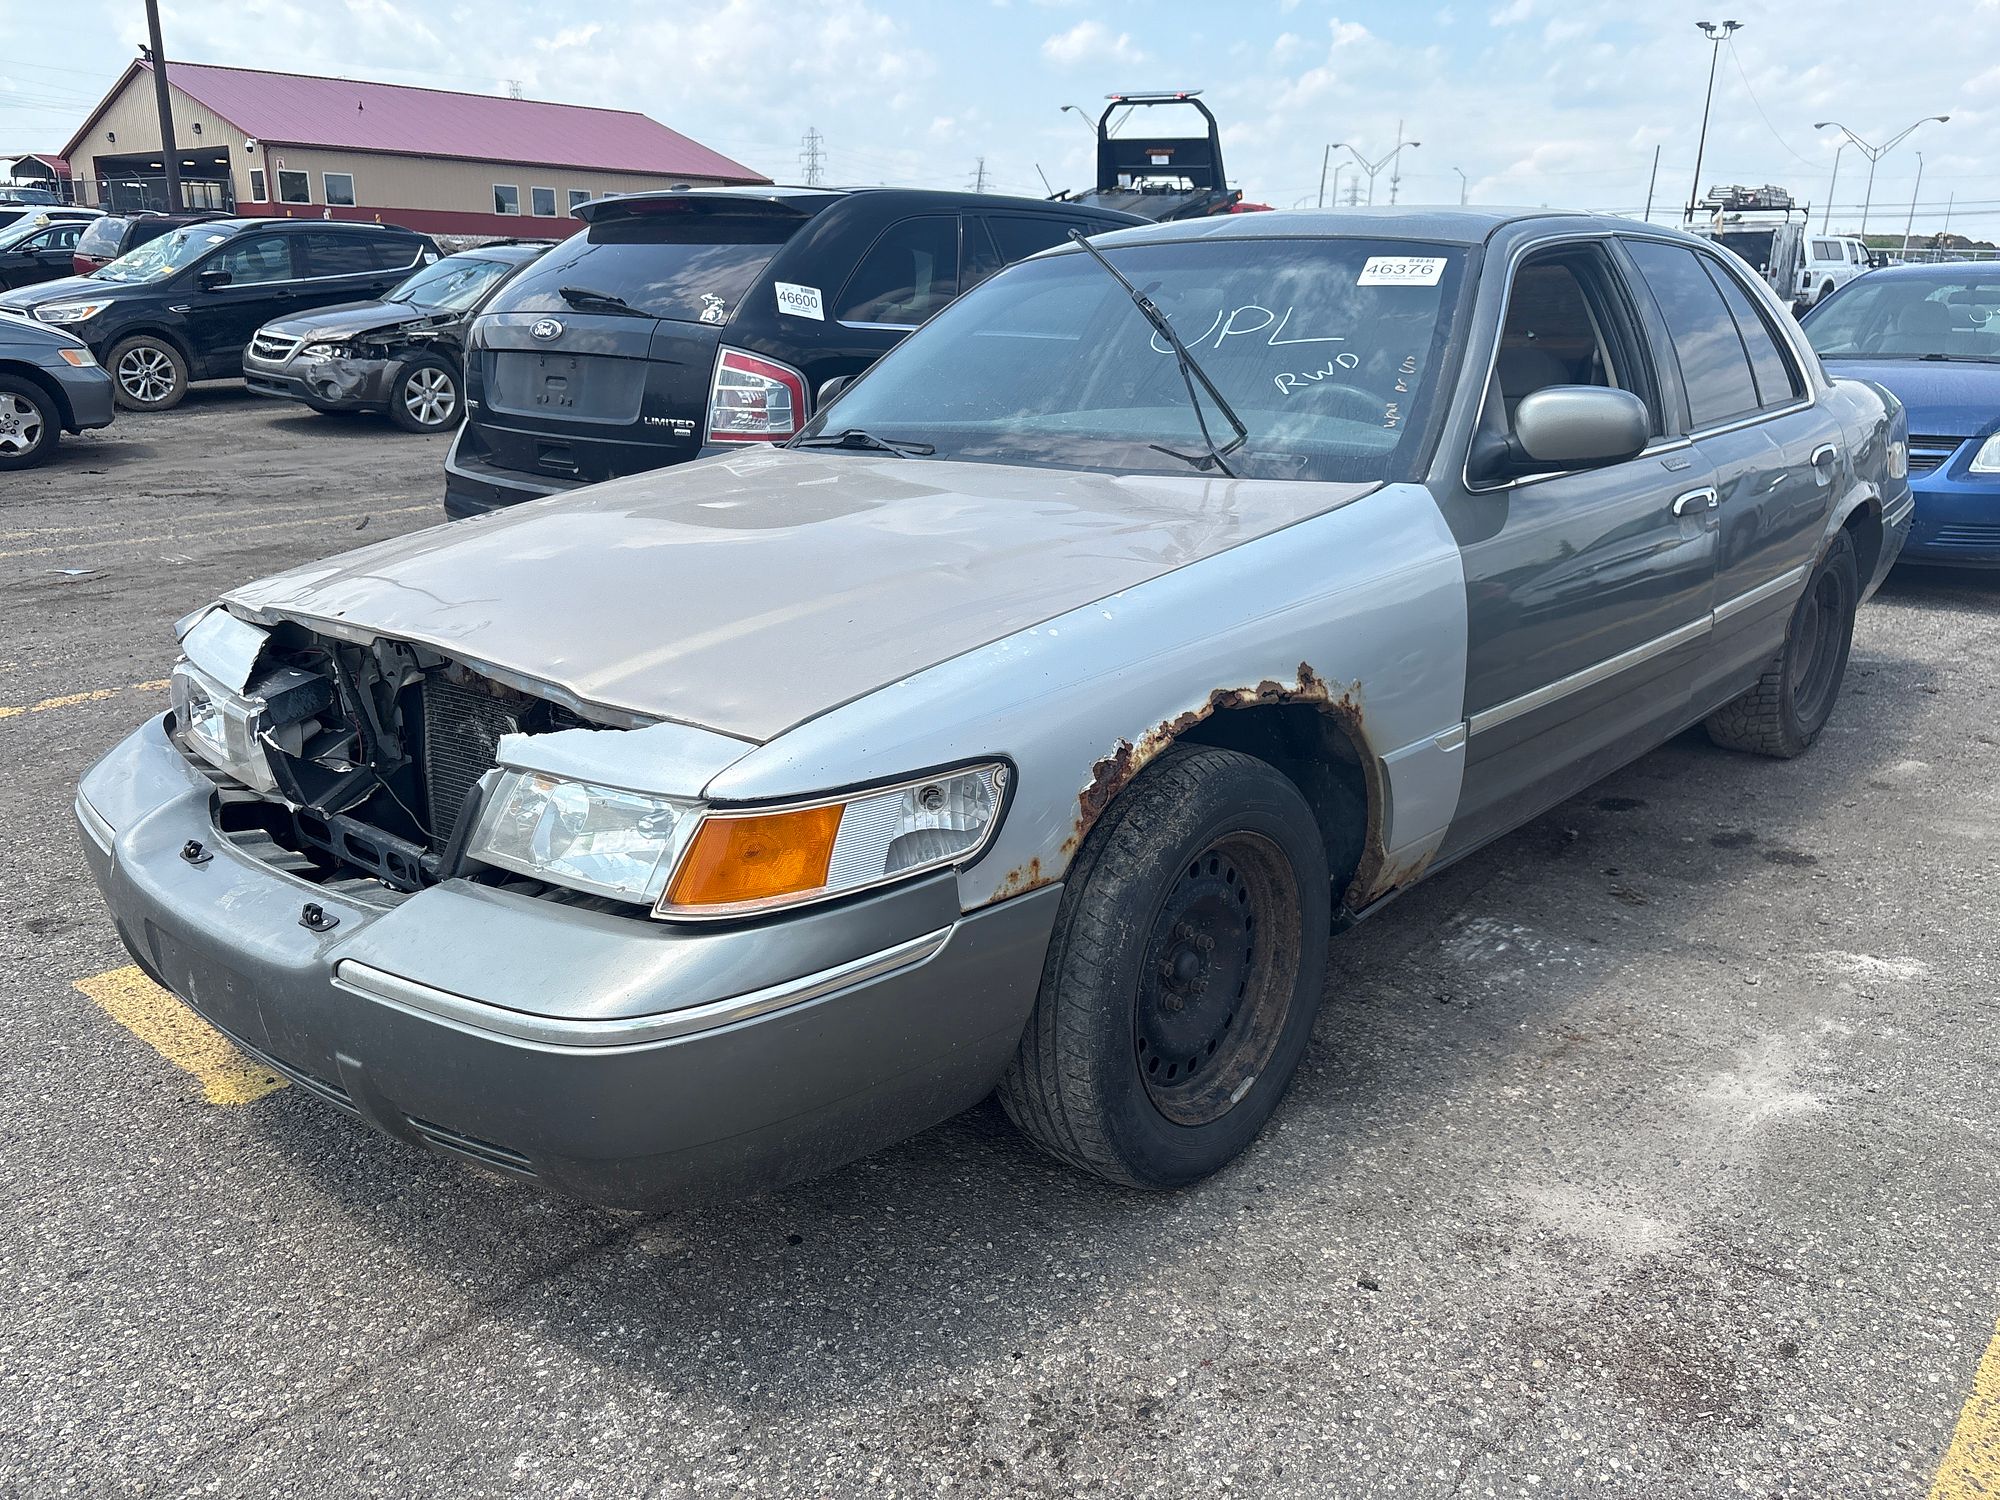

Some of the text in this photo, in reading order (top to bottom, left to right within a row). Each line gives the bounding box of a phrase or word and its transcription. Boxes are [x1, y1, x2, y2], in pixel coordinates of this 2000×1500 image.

[278, 160, 284, 169] A
[1366, 264, 1434, 275] 46376
[779, 291, 818, 309] 46600
[534, 322, 554, 336] Ford
[1150, 305, 1345, 353] UPL
[1274, 352, 1360, 395] RWD
[644, 416, 696, 429] LIMITED
